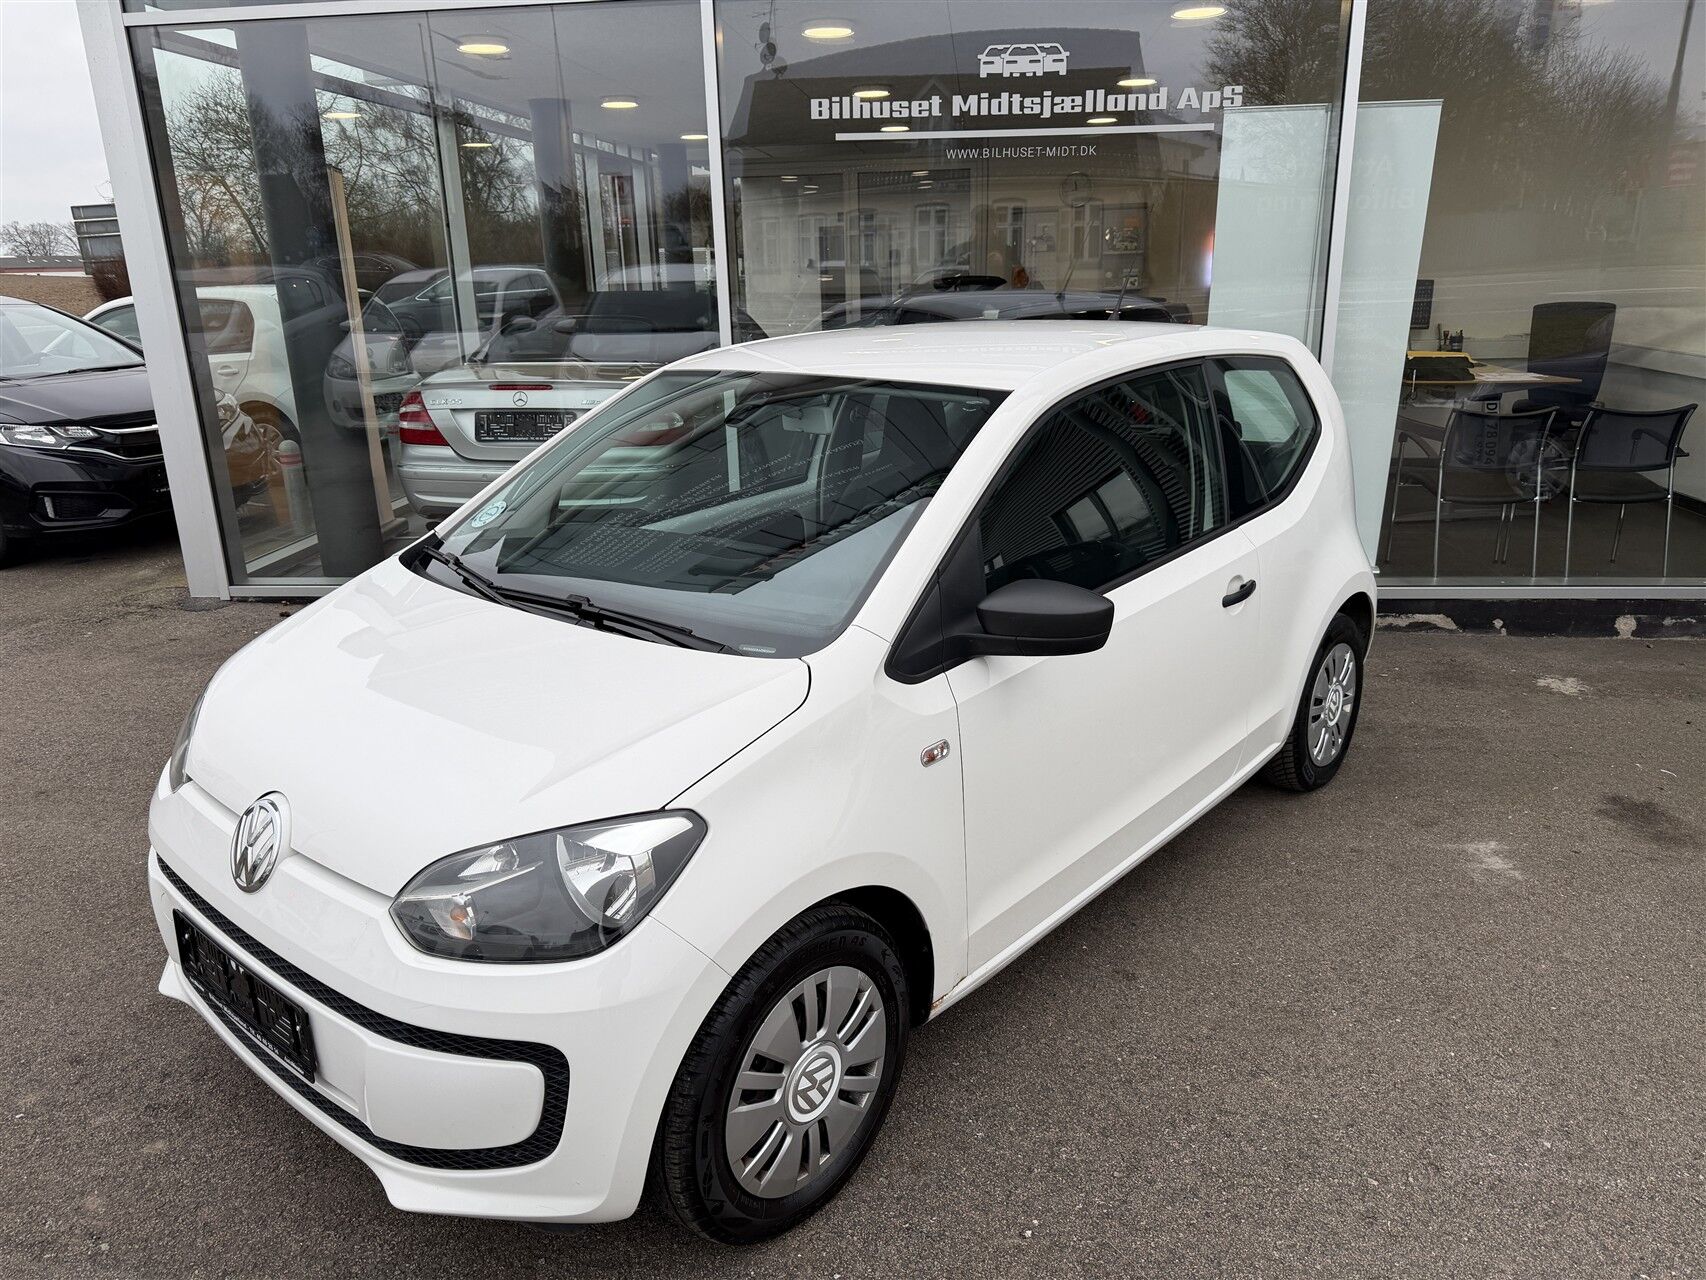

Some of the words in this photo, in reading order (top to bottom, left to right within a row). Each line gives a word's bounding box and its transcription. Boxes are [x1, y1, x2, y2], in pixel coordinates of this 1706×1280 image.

[811, 95, 943, 120] Bilhuset
[952, 87, 1168, 118] Midtsjælland
[1176, 85, 1244, 113] ApS
[946, 145, 1098, 160] WWW.BILHUSET-MIDT.DK
